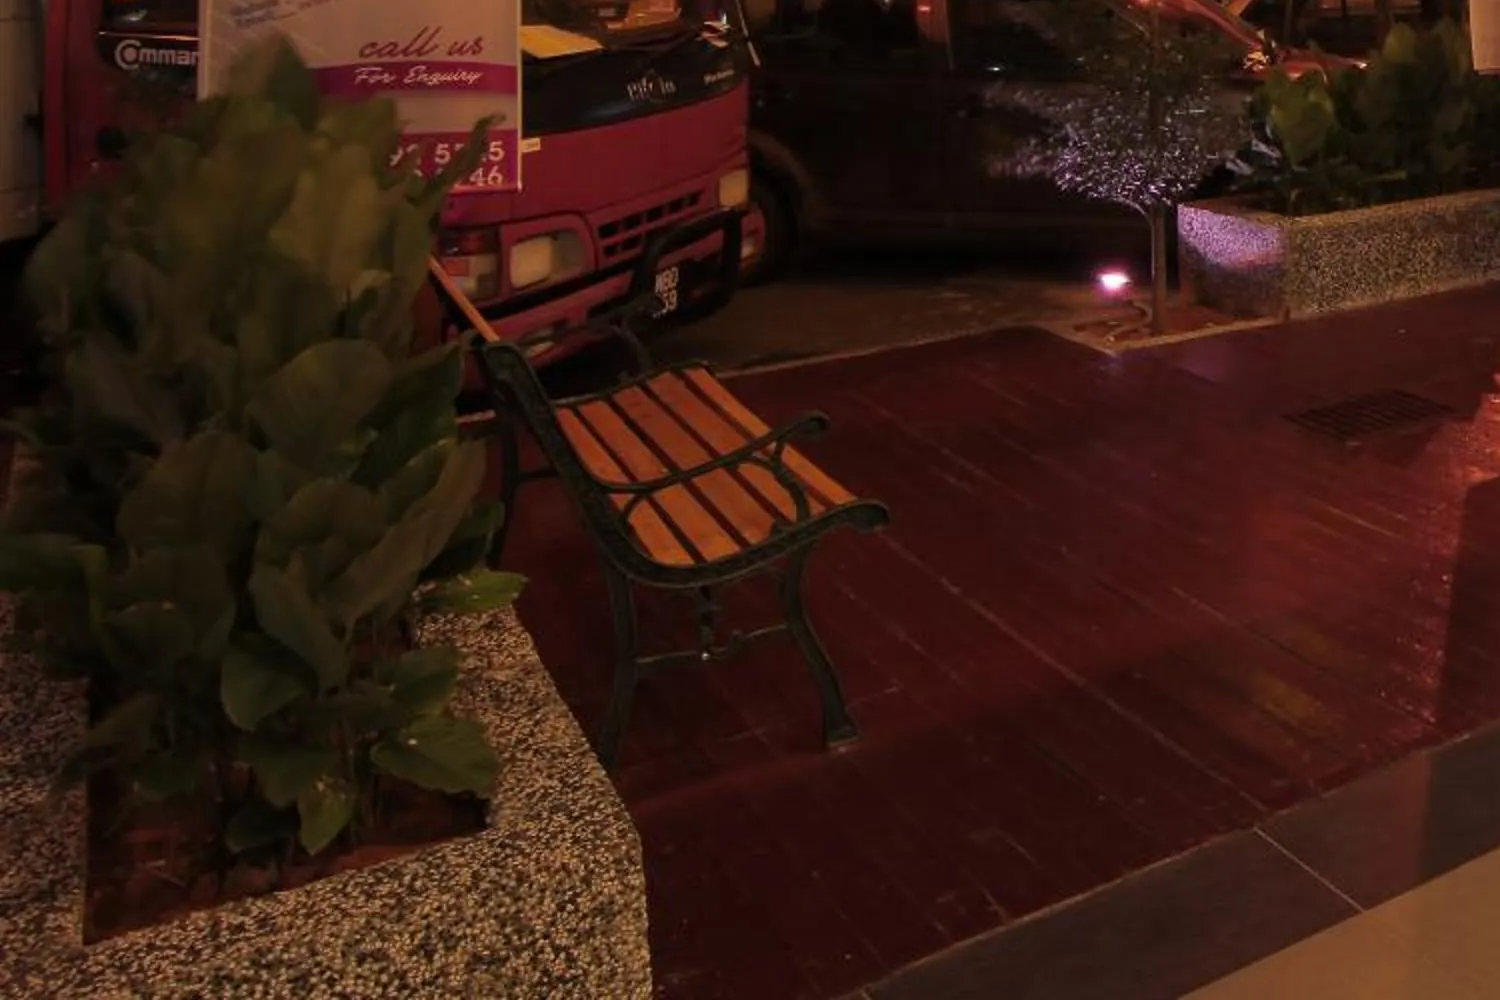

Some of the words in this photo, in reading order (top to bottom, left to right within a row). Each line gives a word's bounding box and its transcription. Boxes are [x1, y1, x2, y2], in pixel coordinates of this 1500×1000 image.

[359, 26, 442, 58] call
[447, 37, 483, 56] us
[354, 66, 395, 85] For
[403, 65, 483, 86] Enquiry
